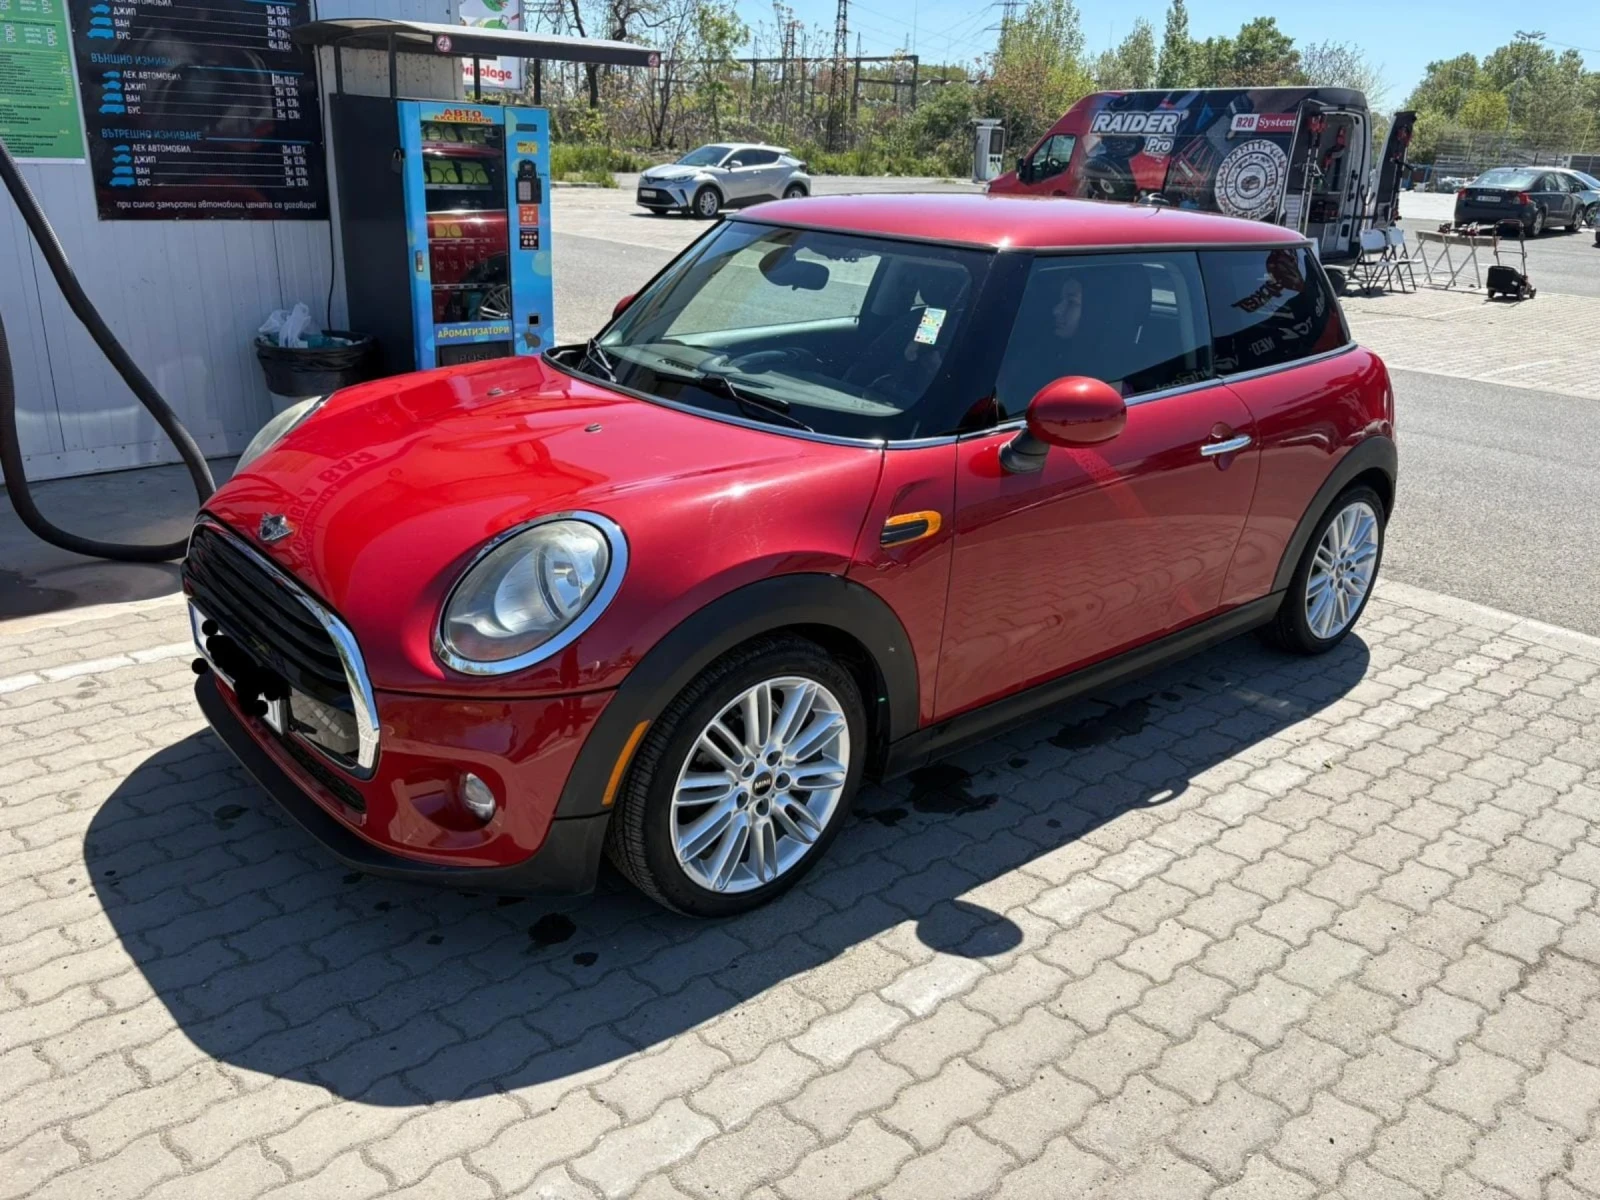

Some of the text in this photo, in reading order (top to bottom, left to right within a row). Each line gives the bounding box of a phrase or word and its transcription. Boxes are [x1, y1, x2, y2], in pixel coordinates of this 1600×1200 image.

[113, 6, 136, 16] ДЖИП
[114, 19, 130, 27] ВАН
[116, 31, 131, 40] БУС
[91, 53, 132, 64] ВЪНШНО
[122, 70, 136, 79] ЛЕК
[138, 71, 181, 81] АВТОМОБИЛ
[124, 82, 147, 91] ДЖИП
[125, 94, 140, 103] ВАН
[127, 106, 141, 114] БУС
[1091, 113, 1178, 133] RAIDER
[1258, 117, 1296, 130] System
[102, 128, 202, 140] ВЪТРЕШНО ИЗМИВАНЕ
[132, 144, 147, 152] ЛЕК
[148, 144, 191, 153] АВТОМОБИЛ
[1145, 137, 1171, 152] Pro
[134, 155, 156, 164] ДЖИП
[136, 167, 150, 175] ВАН
[137, 178, 151, 186] БУС
[438, 326, 510, 338] АРОМАТИЗАТОРИ
